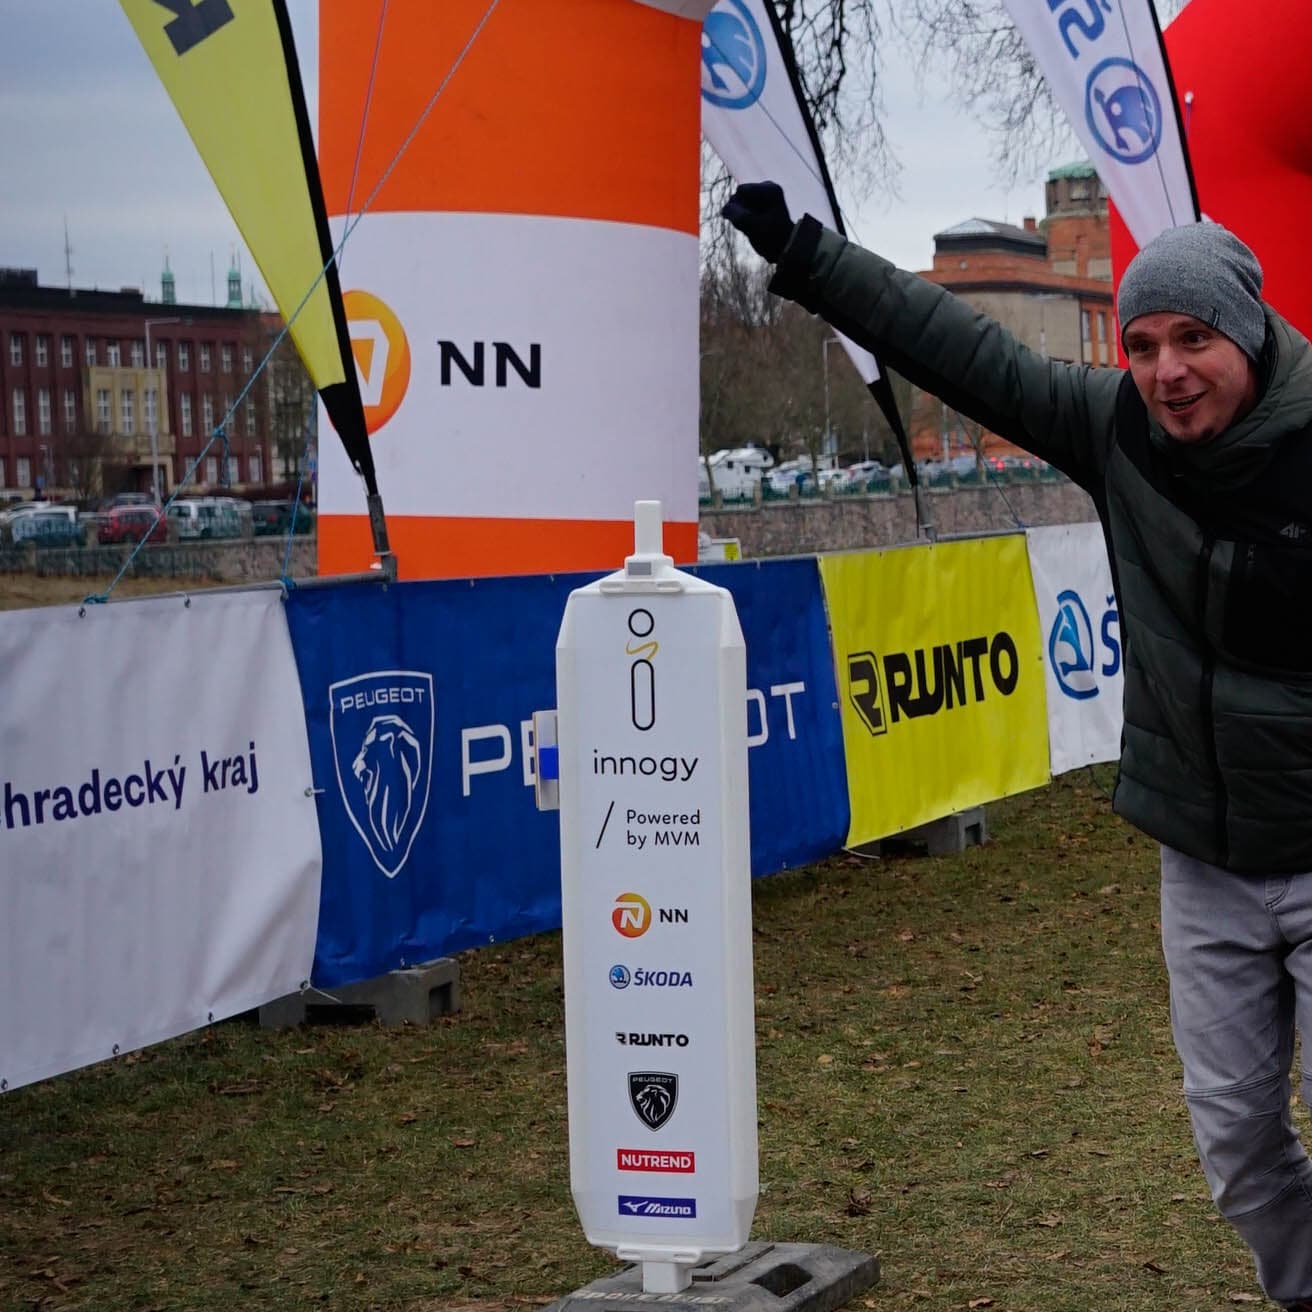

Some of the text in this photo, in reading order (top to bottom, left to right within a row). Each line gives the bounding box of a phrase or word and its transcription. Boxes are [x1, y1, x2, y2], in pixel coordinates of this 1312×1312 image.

[437, 340, 541, 389] NN
[883, 632, 1019, 723] RUNTO
[340, 687, 425, 715] PEUGEOT
[593, 748, 699, 782] innogy
[0, 741, 259, 830] hradecký kraj
[626, 808, 702, 826] Powered
[626, 829, 701, 850] by MVM
[658, 908, 689, 924] NN
[633, 967, 694, 988] ŠKODA
[628, 1032, 690, 1048] RUNTO
[620, 1153, 692, 1169] NUTREND
